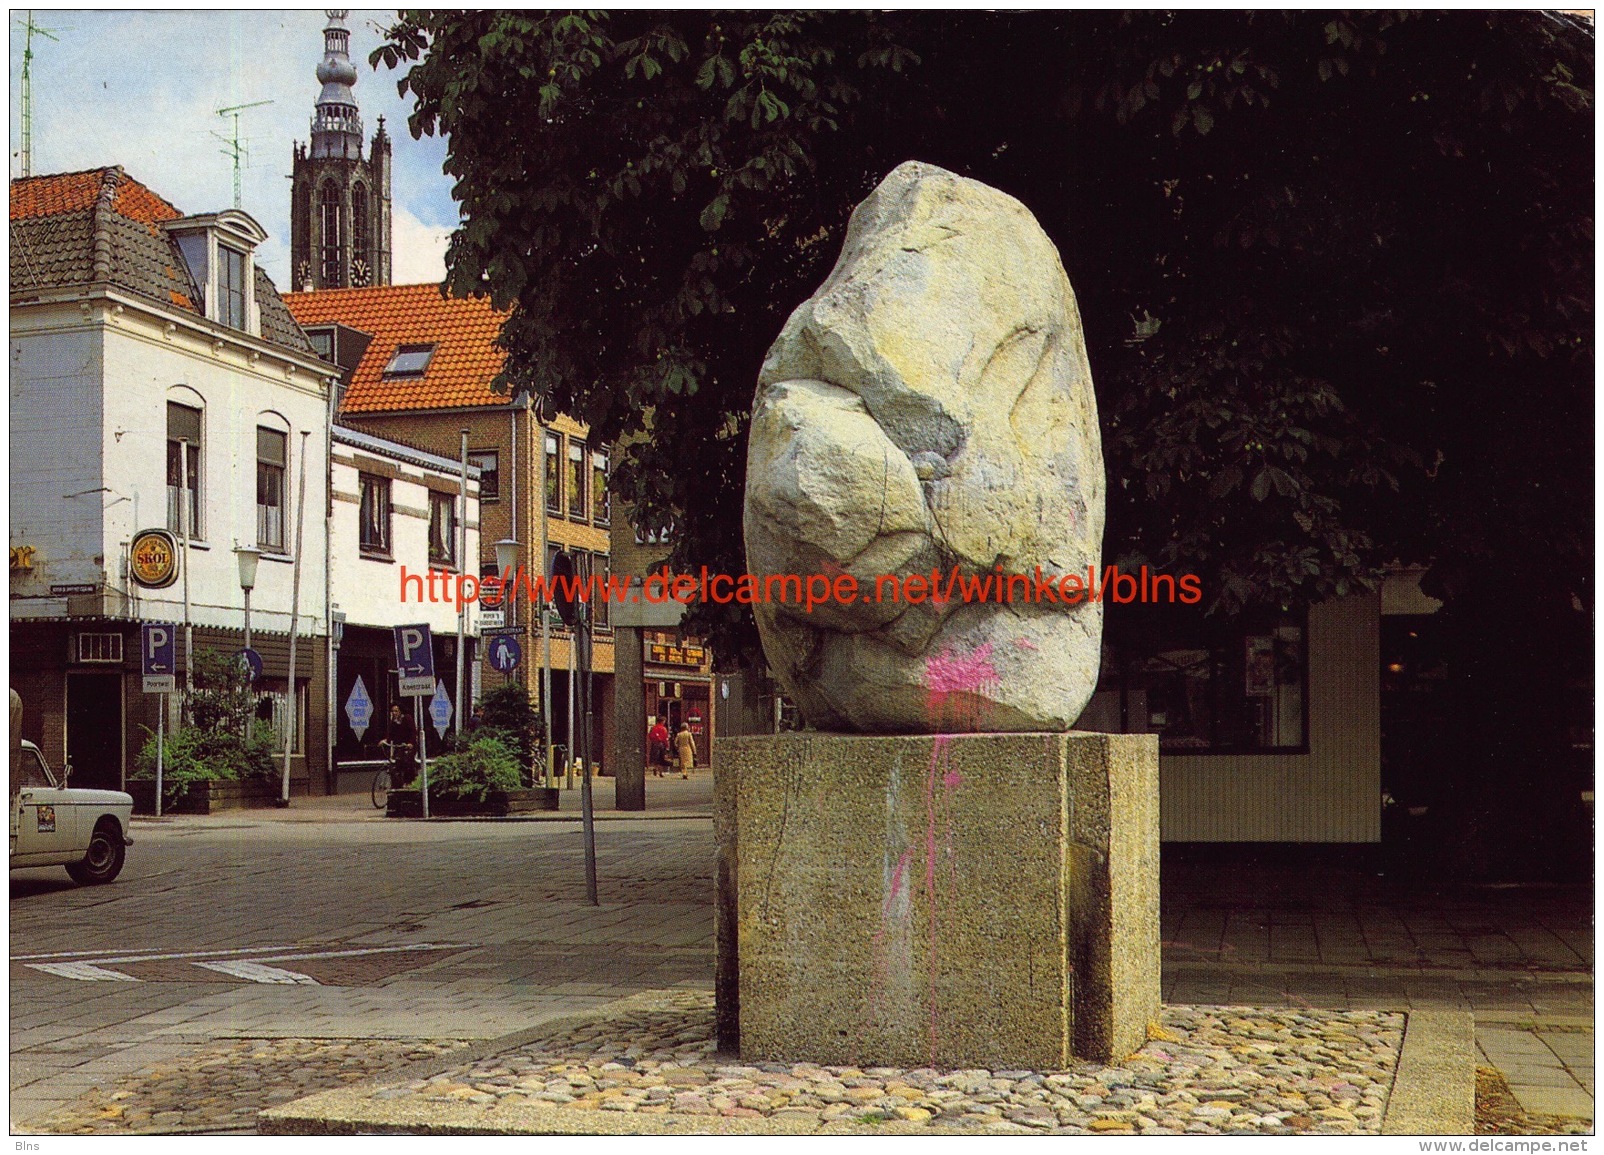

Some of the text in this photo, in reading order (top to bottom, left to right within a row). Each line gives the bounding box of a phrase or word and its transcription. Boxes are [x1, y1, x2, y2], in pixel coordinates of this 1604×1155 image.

[137, 553, 168, 564] SKOL
[149, 628, 168, 659] P
[401, 629, 423, 661] P
